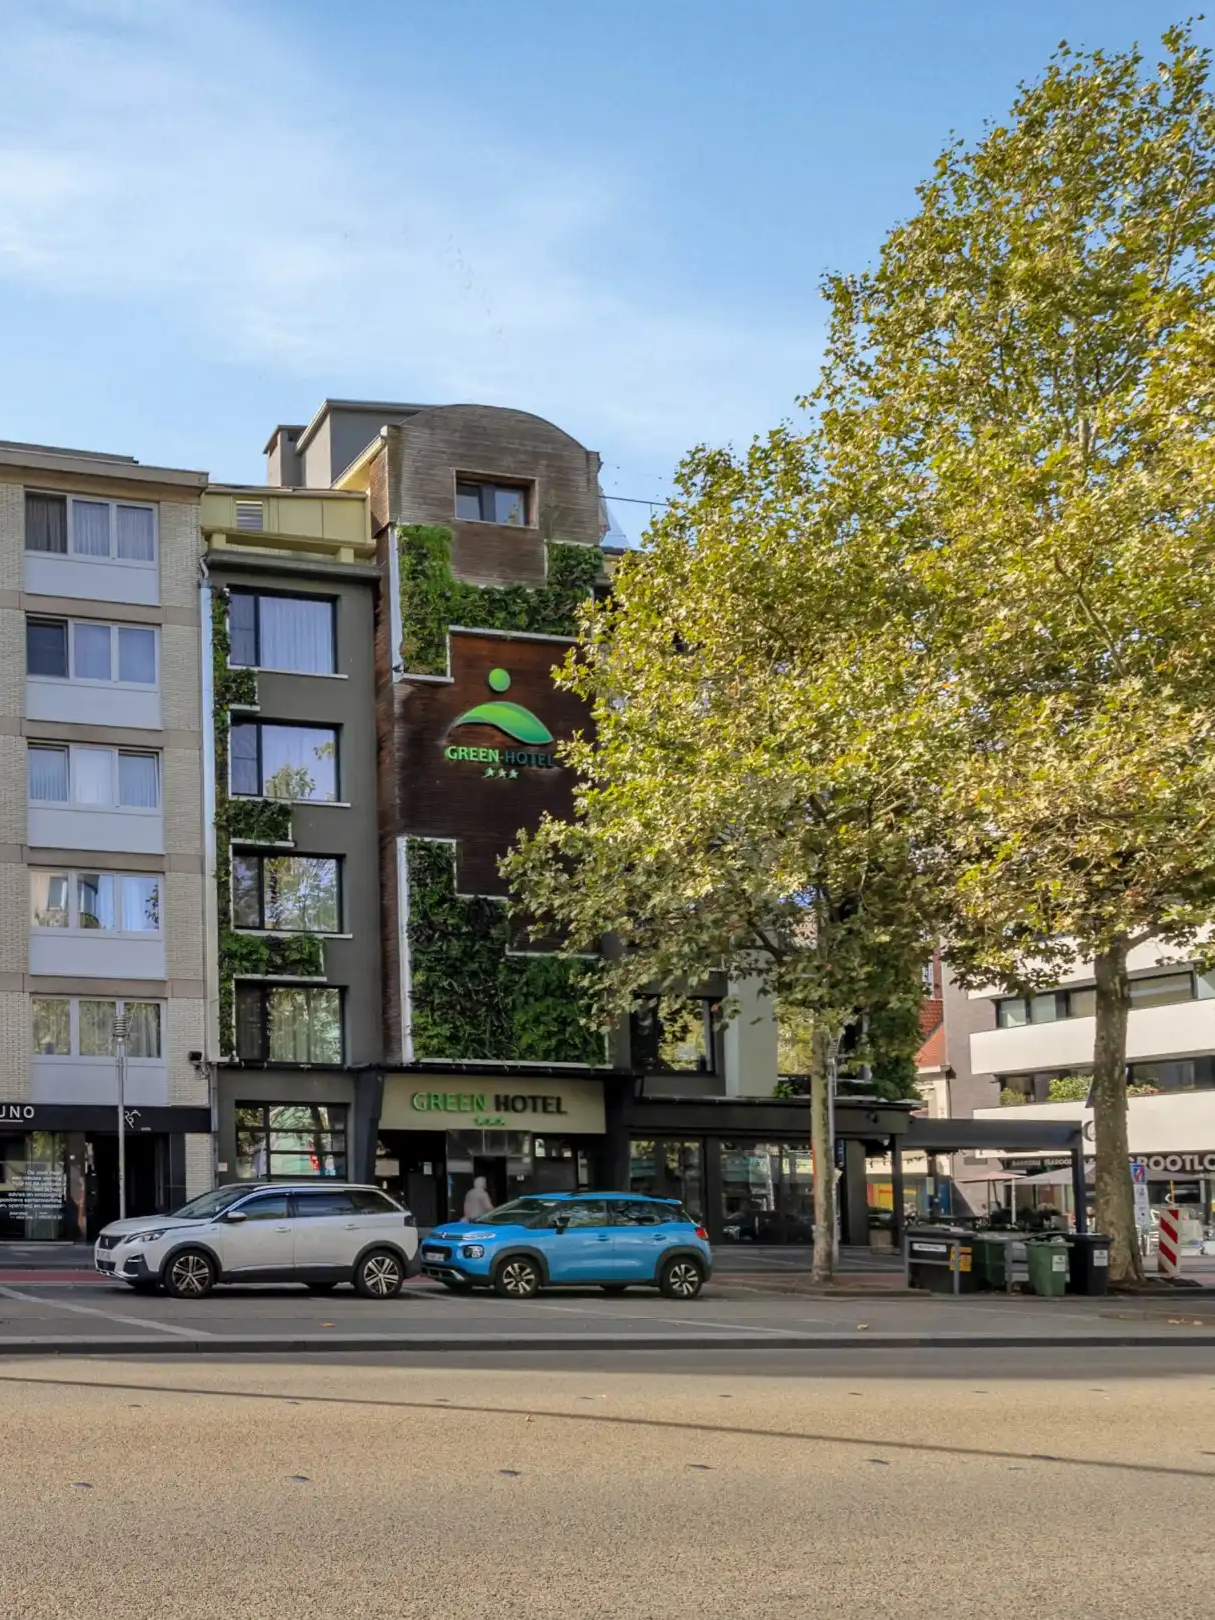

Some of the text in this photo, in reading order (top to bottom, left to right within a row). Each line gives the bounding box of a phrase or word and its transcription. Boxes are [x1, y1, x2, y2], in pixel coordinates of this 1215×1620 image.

[445, 745, 554, 767] GREEN HOTEL
[411, 1092, 568, 1115] GREEN HOTEL
